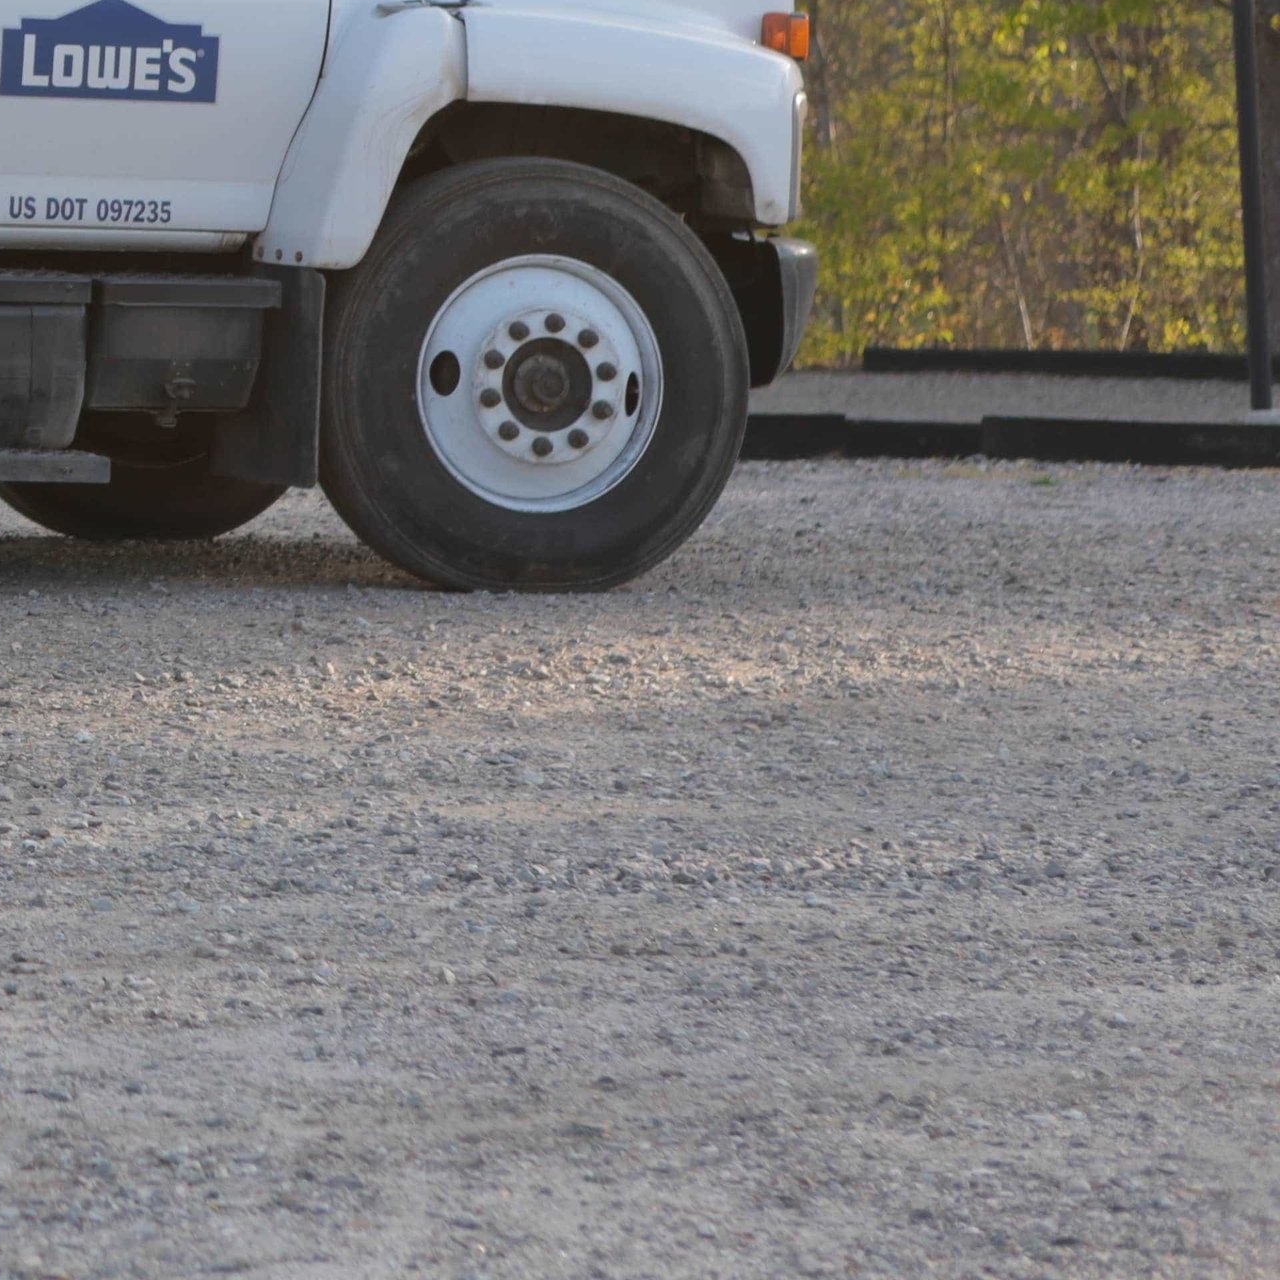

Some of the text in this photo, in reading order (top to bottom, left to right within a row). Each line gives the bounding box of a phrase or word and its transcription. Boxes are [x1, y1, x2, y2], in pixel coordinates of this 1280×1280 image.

[21, 33, 197, 93] LOWE'S
[9, 195, 171, 223] US DOT 097235
